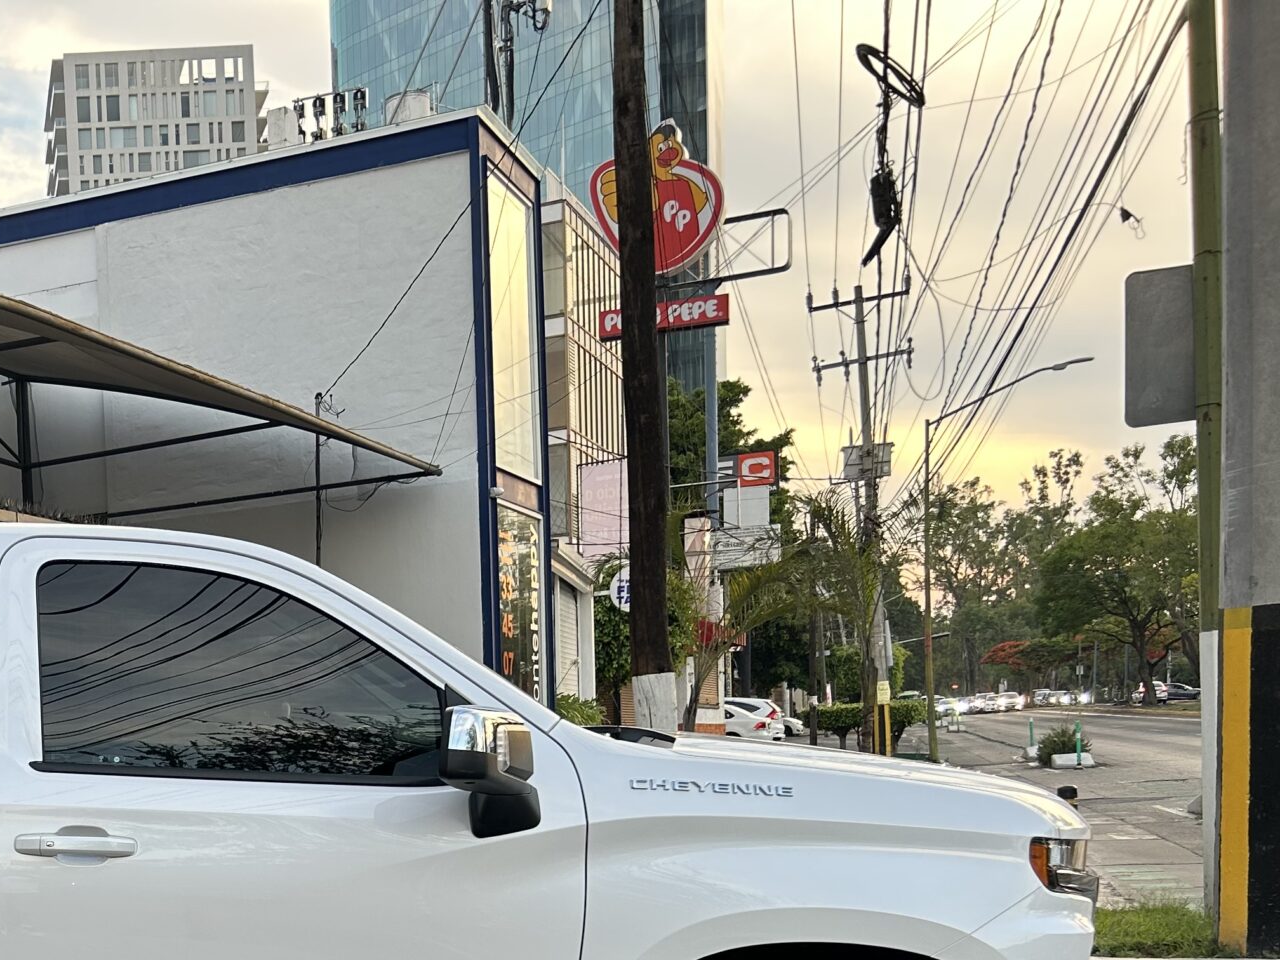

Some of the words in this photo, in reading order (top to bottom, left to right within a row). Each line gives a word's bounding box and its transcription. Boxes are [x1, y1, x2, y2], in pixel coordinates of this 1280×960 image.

[668, 299, 718, 323] PEPE
[501, 574, 513, 601] 33
[502, 612, 514, 639] 45
[502, 651, 514, 676] 07
[629, 778, 794, 798] CHEYENNE
